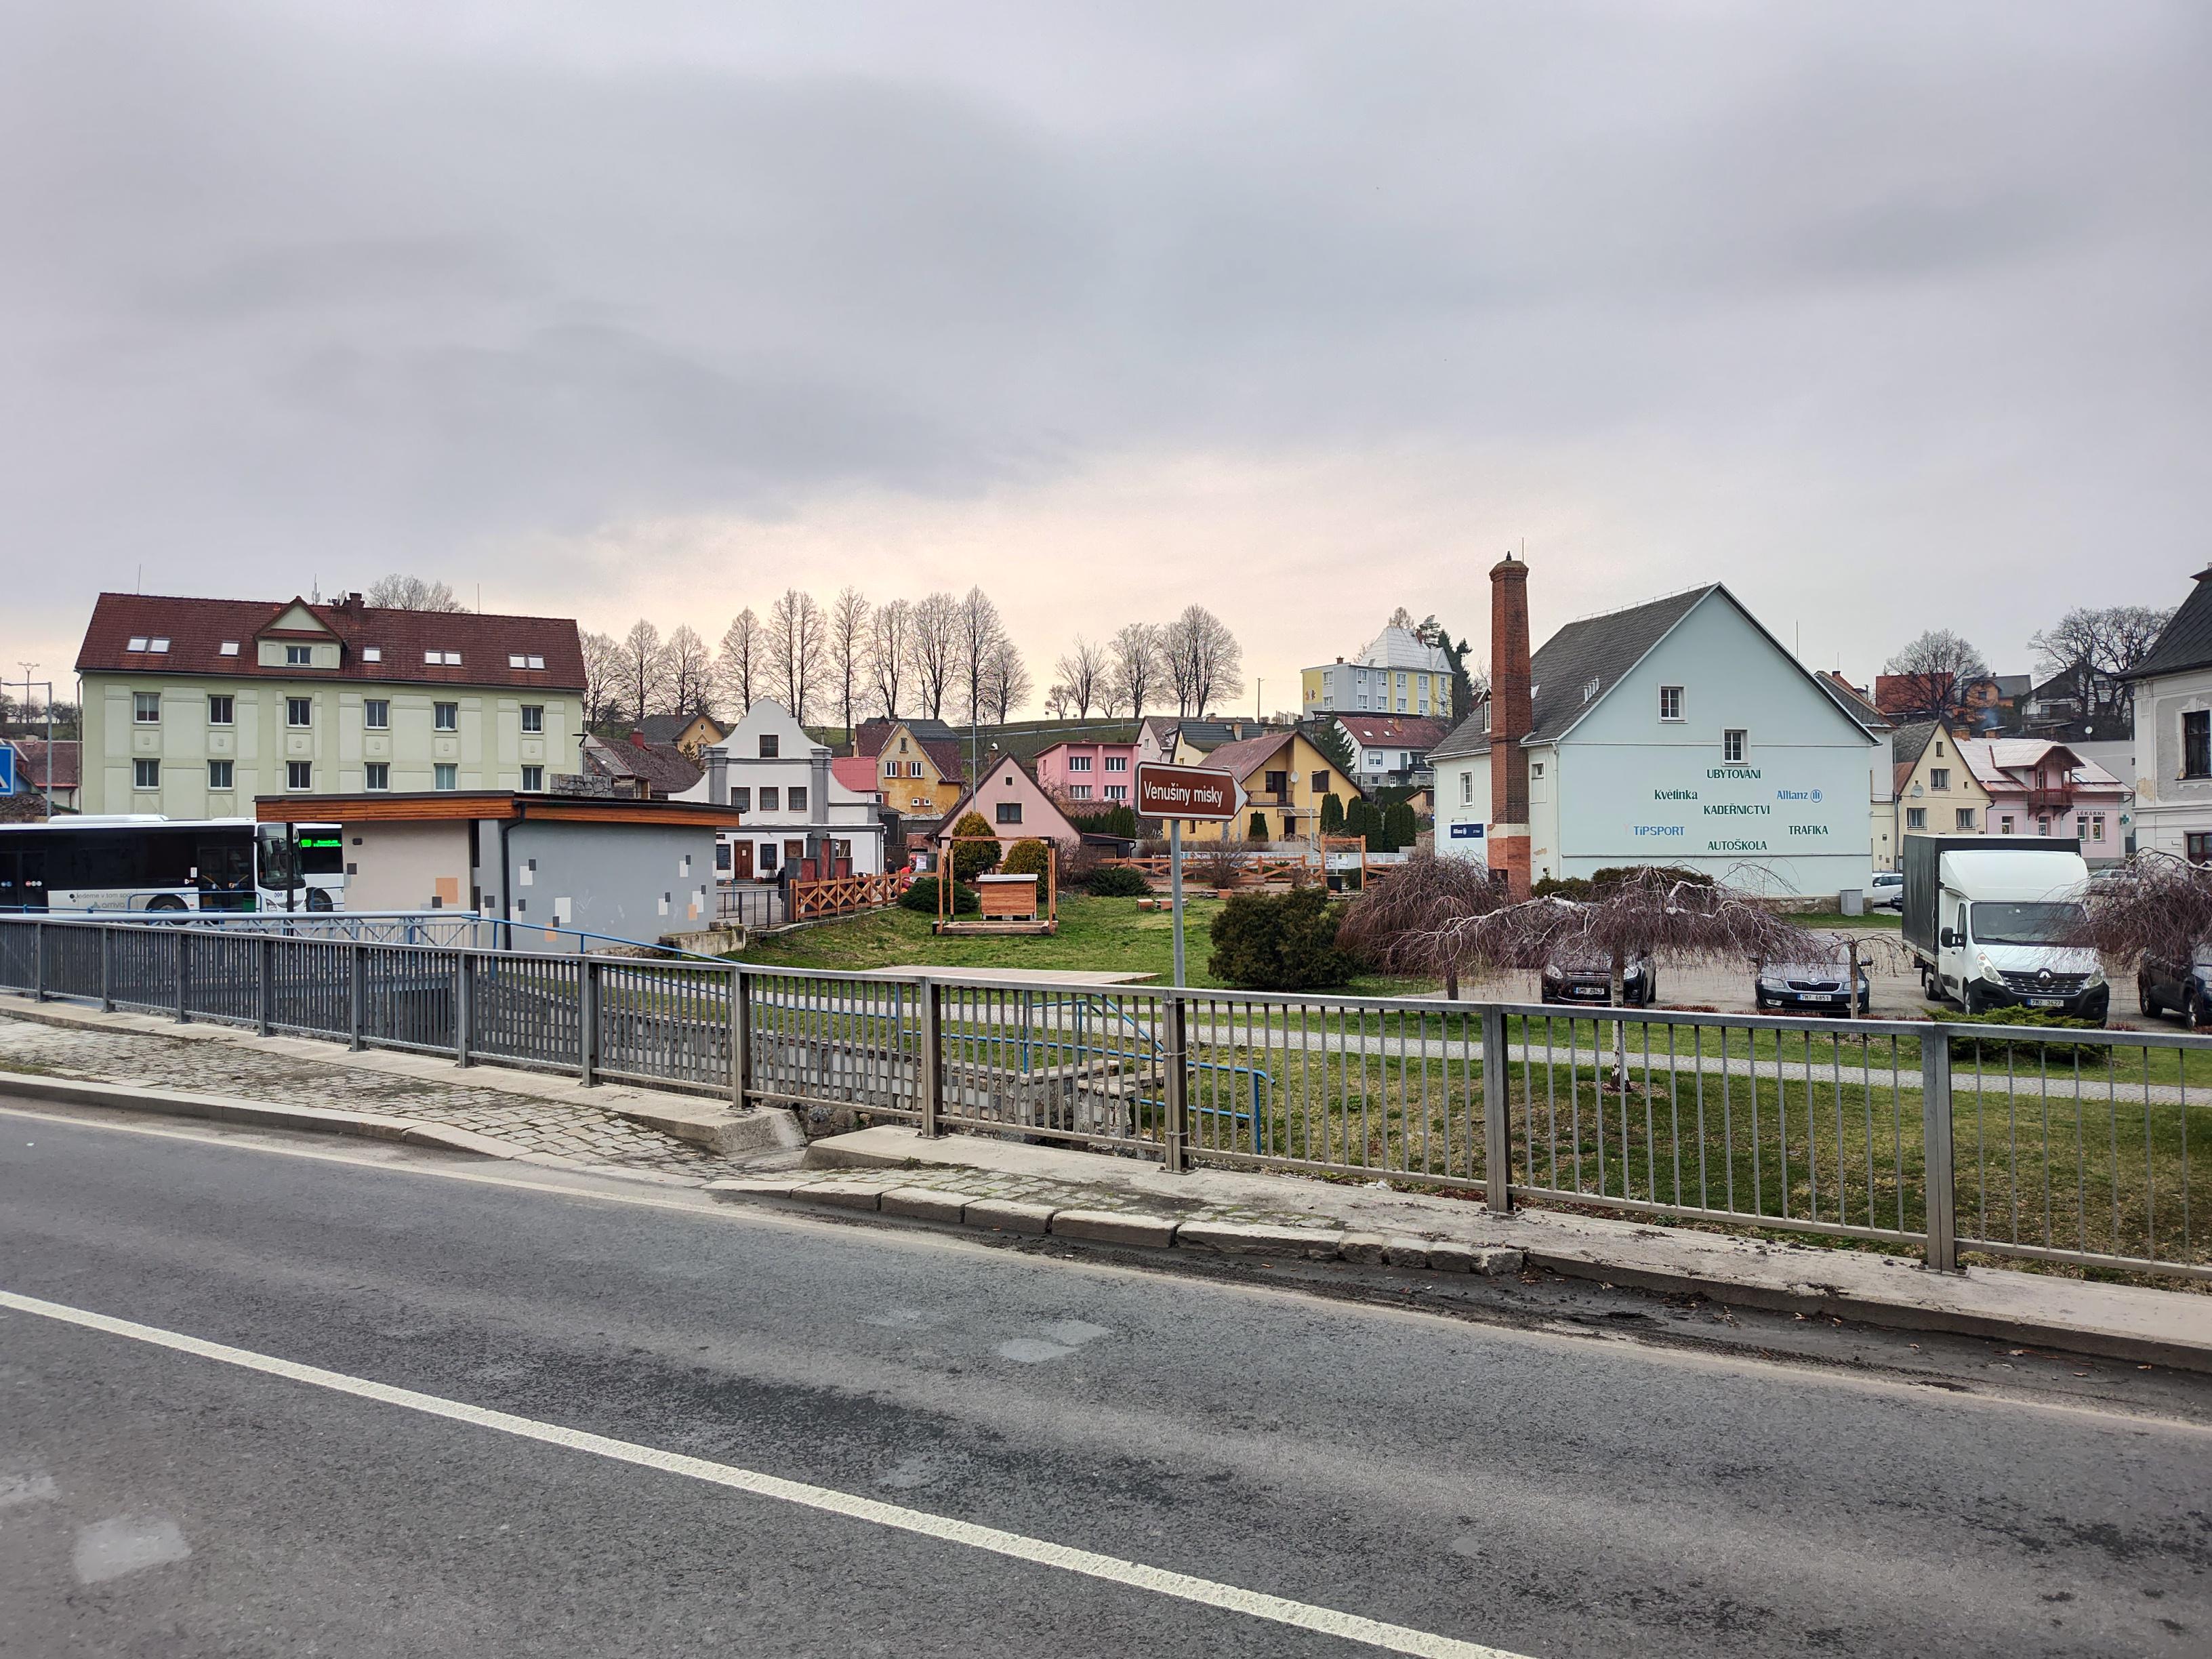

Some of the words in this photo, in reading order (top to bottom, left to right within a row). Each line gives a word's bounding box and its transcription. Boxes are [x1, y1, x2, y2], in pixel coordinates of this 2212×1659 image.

[1706, 768, 1761, 779] UBYTOVÁNÍ
[1143, 781, 1191, 806] Venušiny
[1193, 785, 1223, 808] misky
[1654, 789, 1698, 800] Květinka
[1776, 790, 1808, 800] Allianz
[1703, 803, 1770, 815] KADEŘNICTVÍ
[1788, 825, 1828, 835] TRAFIKA
[1707, 838, 1767, 851] AUTOŠKOLA
